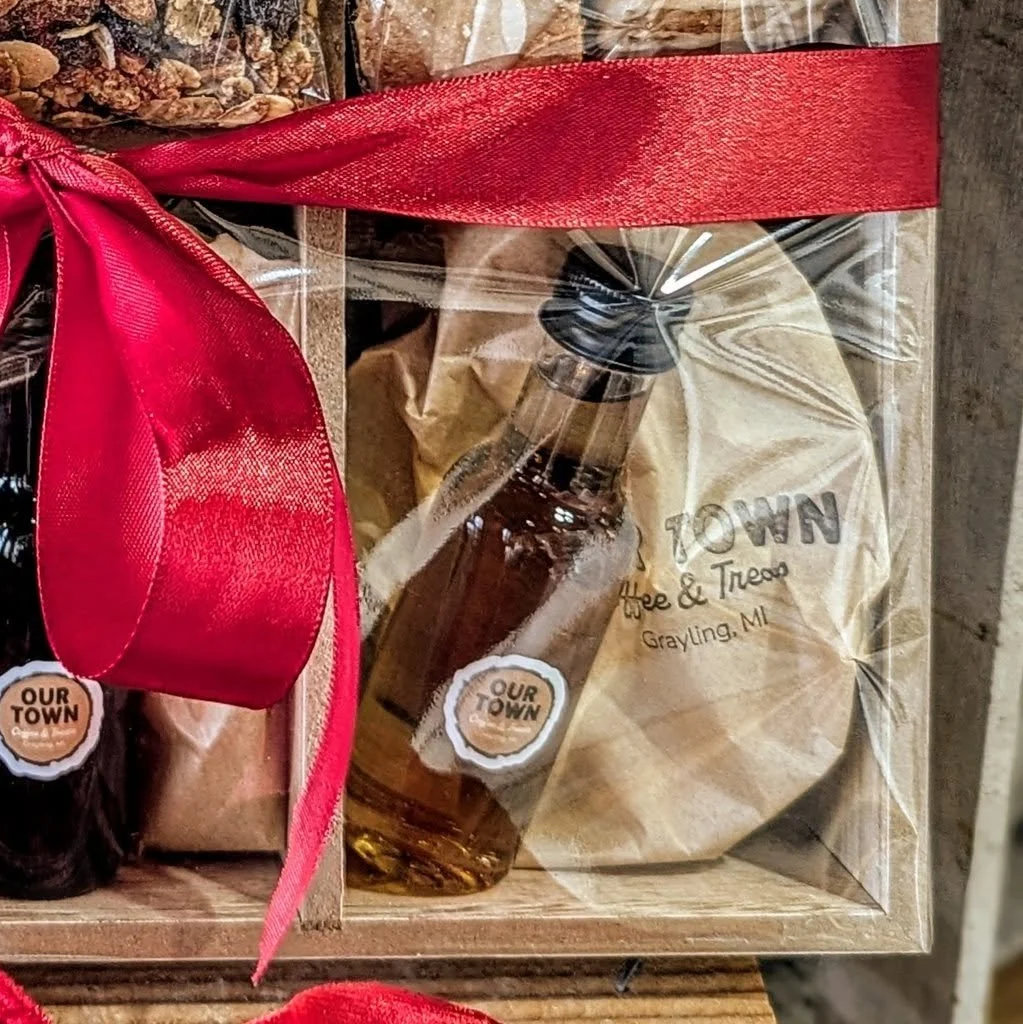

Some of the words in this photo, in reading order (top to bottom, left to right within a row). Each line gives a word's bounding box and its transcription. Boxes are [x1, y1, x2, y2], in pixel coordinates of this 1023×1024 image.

[664, 491, 841, 564] TOWN
[618, 579, 671, 620] ffee
[677, 572, 708, 610] &
[710, 559, 790, 600] Treas
[641, 622, 737, 654] Grayling,
[740, 604, 769, 634] MI
[21, 687, 70, 706] OUR
[490, 679, 538, 703] OUR
[10, 704, 79, 725] TOWN
[476, 692, 542, 721] TOWN
